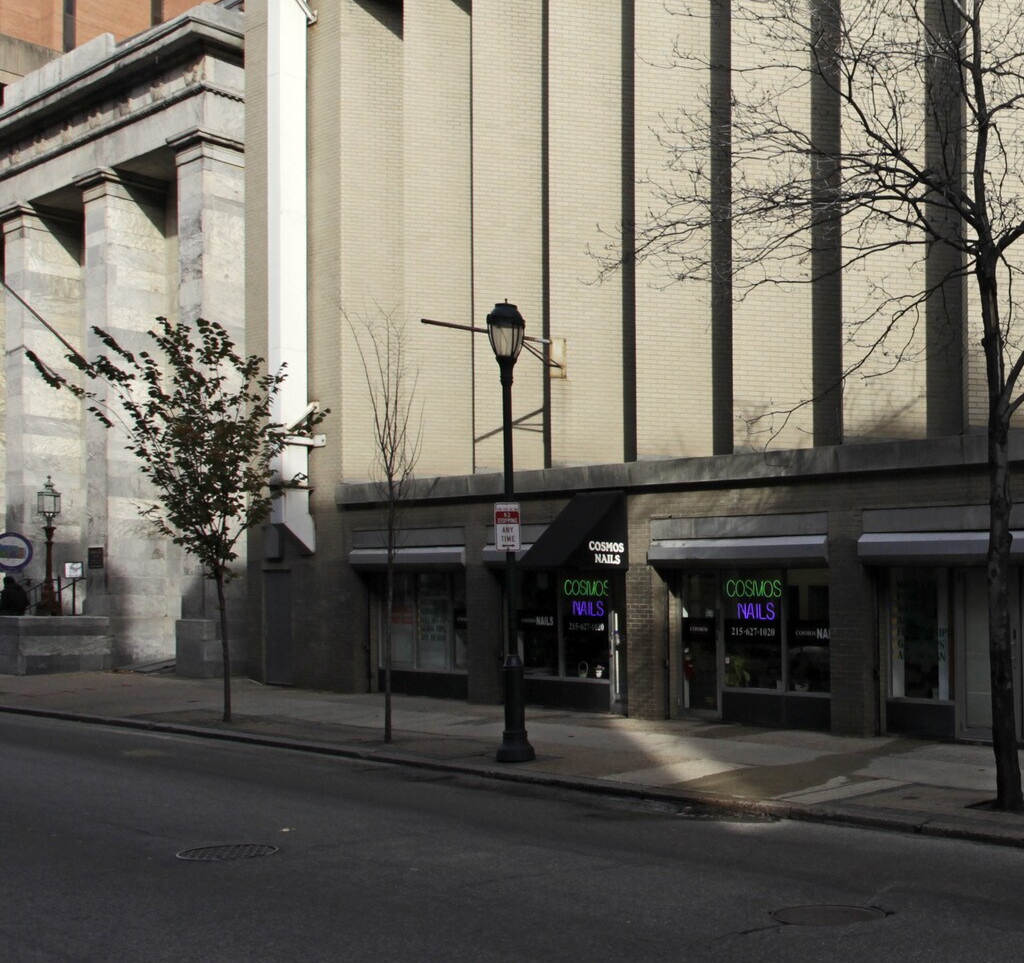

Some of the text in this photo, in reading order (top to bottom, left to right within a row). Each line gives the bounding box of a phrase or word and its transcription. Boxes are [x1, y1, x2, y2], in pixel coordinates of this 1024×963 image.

[501, 535, 516, 543] TIME
[588, 540, 625, 553] COSMOS
[594, 553, 621, 565] NAILS
[564, 579, 609, 597] COSMOS
[725, 579, 782, 598] COSMOS
[572, 600, 605, 617] NAILS
[737, 601, 777, 621] NAILS
[535, 615, 554, 626] NAILS
